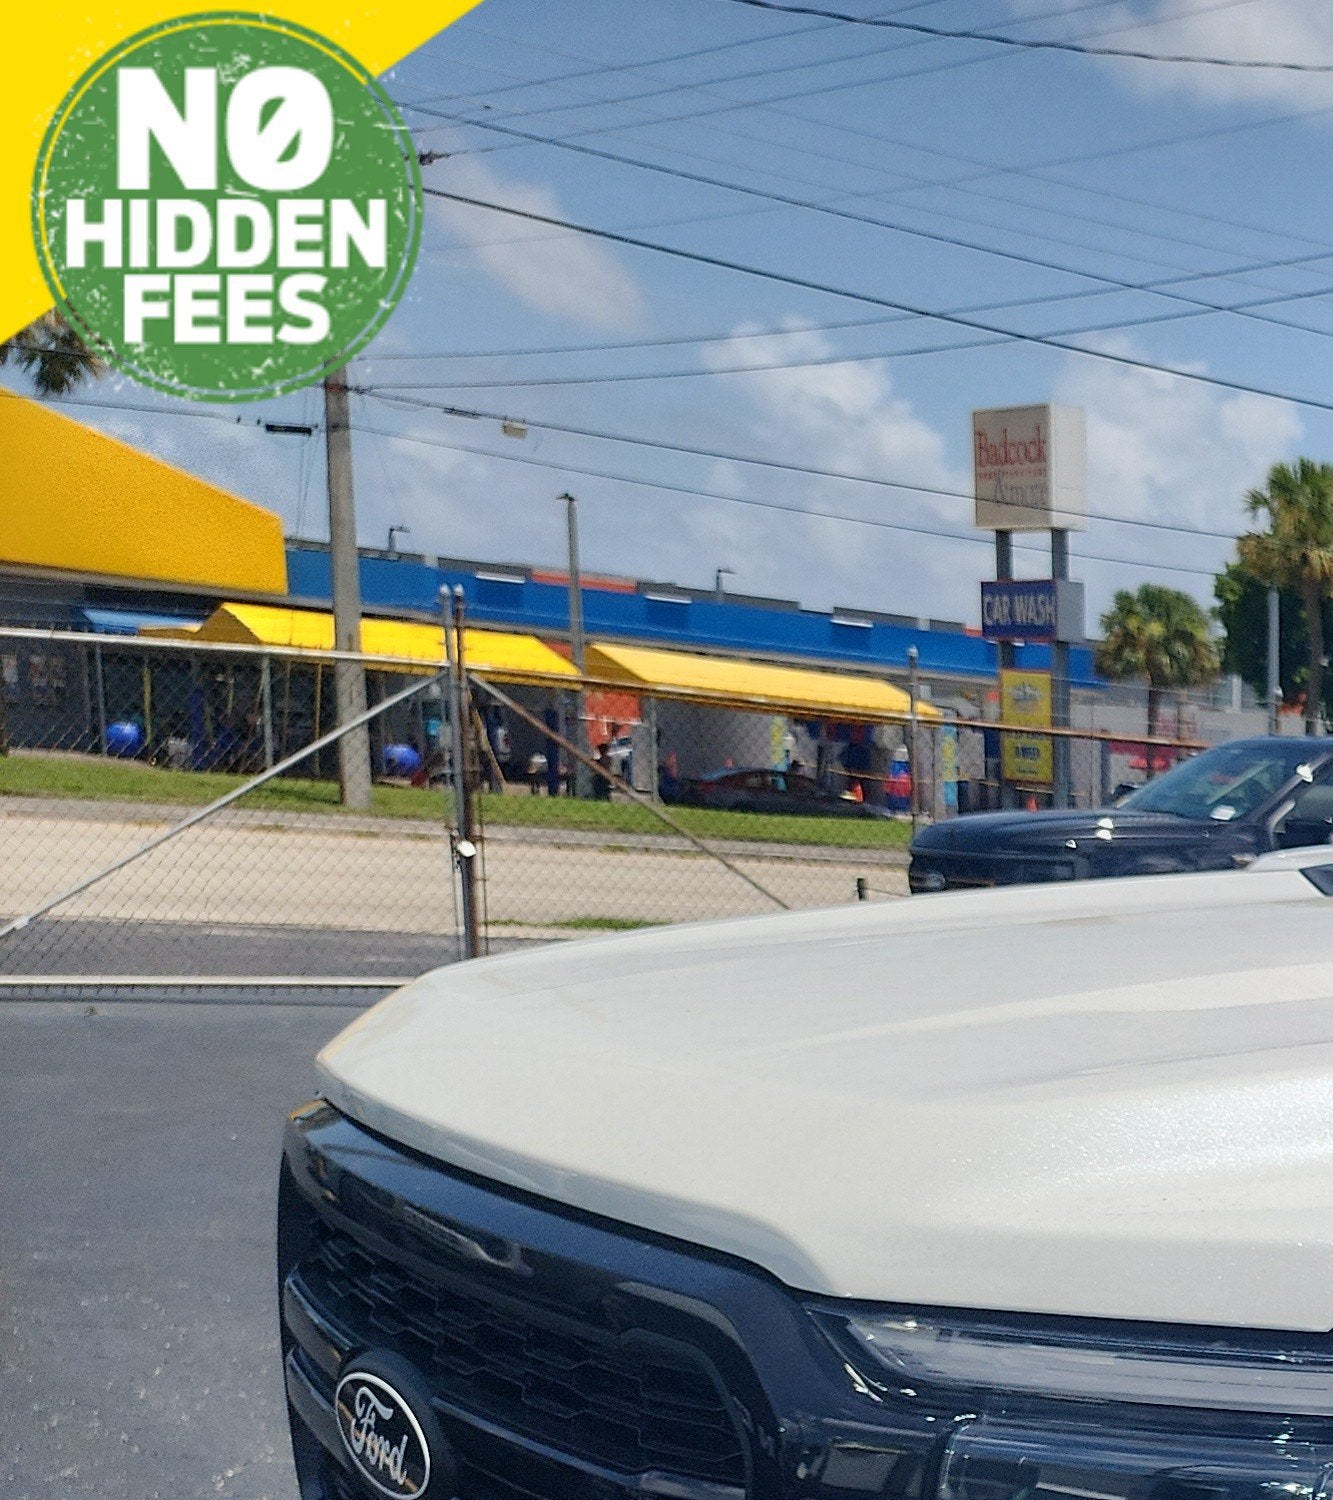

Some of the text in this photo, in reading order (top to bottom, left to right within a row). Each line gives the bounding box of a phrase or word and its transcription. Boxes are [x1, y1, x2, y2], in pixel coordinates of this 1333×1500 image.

[983, 593, 1058, 627] CAR WASH
[351, 1386, 408, 1486] Ford
